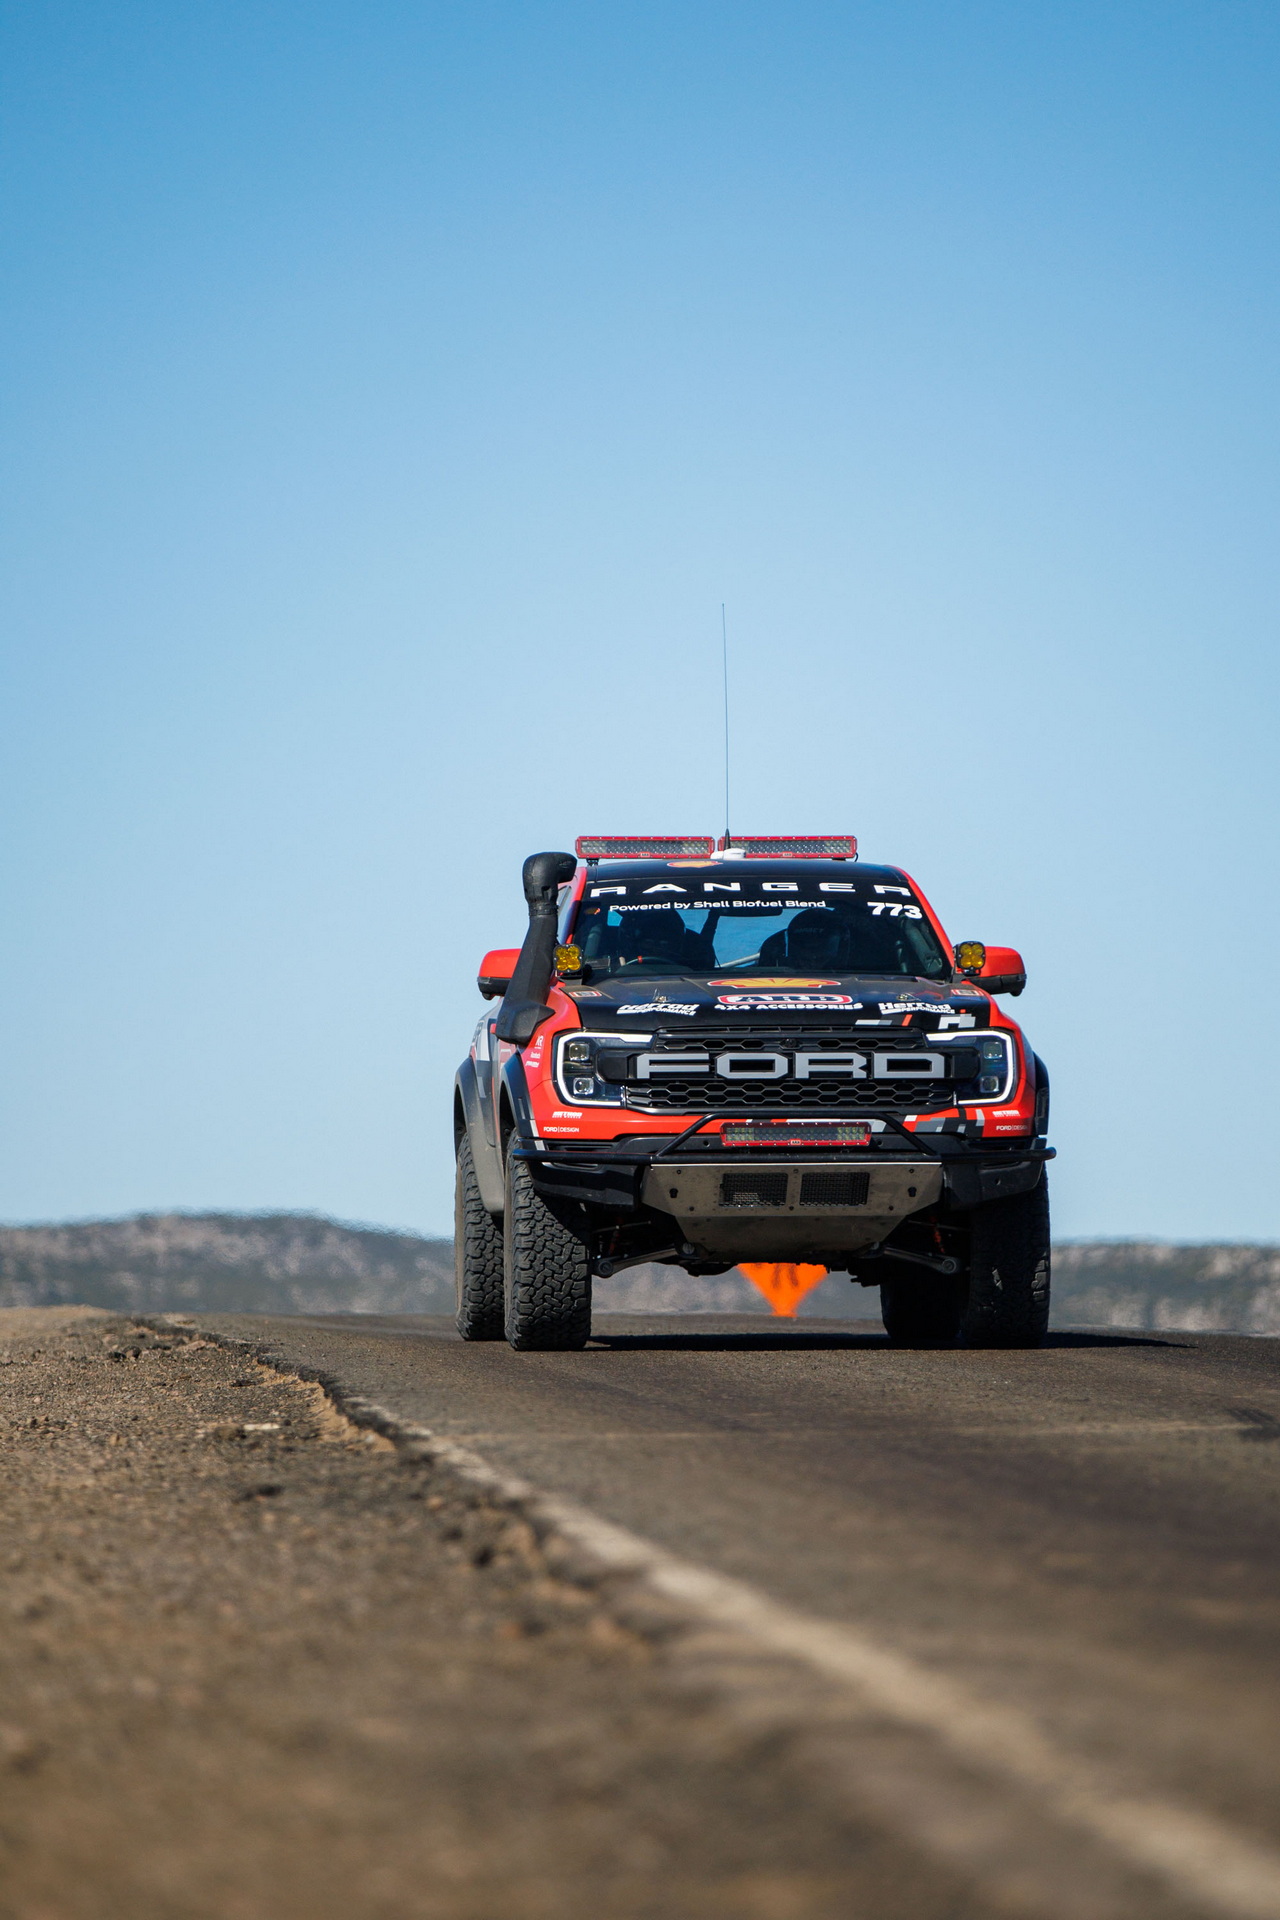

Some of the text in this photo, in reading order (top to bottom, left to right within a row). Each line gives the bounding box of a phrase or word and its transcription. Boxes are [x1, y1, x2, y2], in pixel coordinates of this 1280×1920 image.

[589, 881, 912, 897] RANGER
[609, 899, 827, 913] Powered by Shell Biofuel Blend
[867, 901, 923, 919] 773
[756, 1002, 864, 1010] ACCESSORIES
[878, 1002, 952, 1010] Herrod
[636, 1052, 946, 1079] FORD
